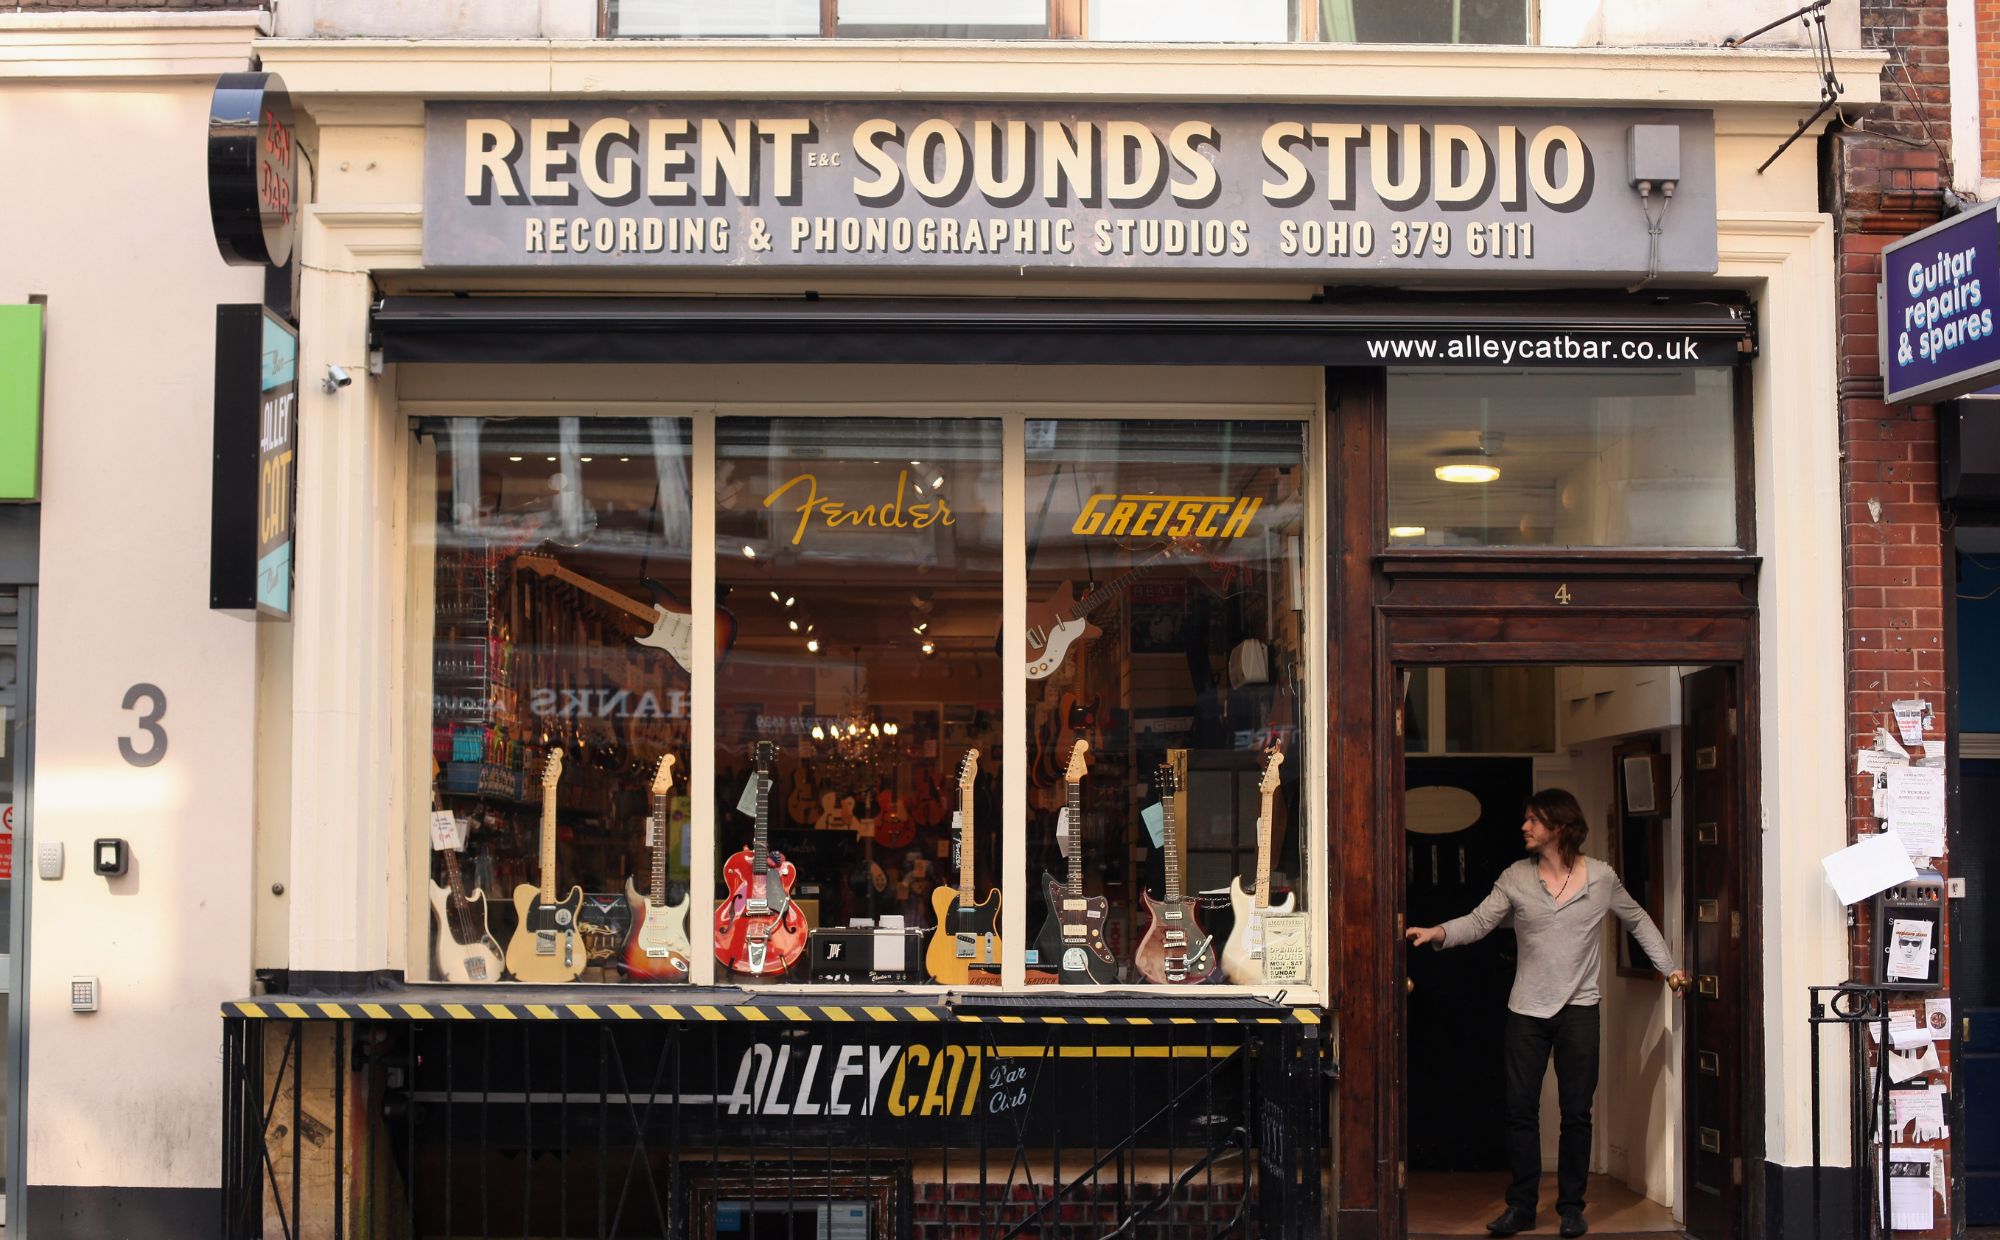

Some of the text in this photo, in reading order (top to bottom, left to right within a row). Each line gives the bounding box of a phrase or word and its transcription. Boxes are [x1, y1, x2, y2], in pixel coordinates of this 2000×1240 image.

[265, 111, 290, 170] ZEN
[464, 118, 1590, 209] REGENT E&C SOUNDS STUDIO
[262, 159, 290, 224] BAR
[525, 217, 1535, 259] RECORDING & PHONOGRAPHIC STUDIOS SOHO 379 6111
[1907, 246, 1977, 299] Guitar
[1905, 277, 1982, 332] repairs
[1366, 335, 1699, 364] www.alleycatbar.co.uk
[1897, 308, 1994, 367] & spares
[260, 393, 294, 453] ALLEY
[260, 449, 292, 545] CAT
[763, 469, 957, 545] Fender
[1071, 494, 1263, 539] GRETSCH
[1554, 583, 1571, 605] 4
[117, 682, 168, 768] 3
[989, 1064, 1027, 1088] Bar
[989, 1088, 1028, 1114] Club
